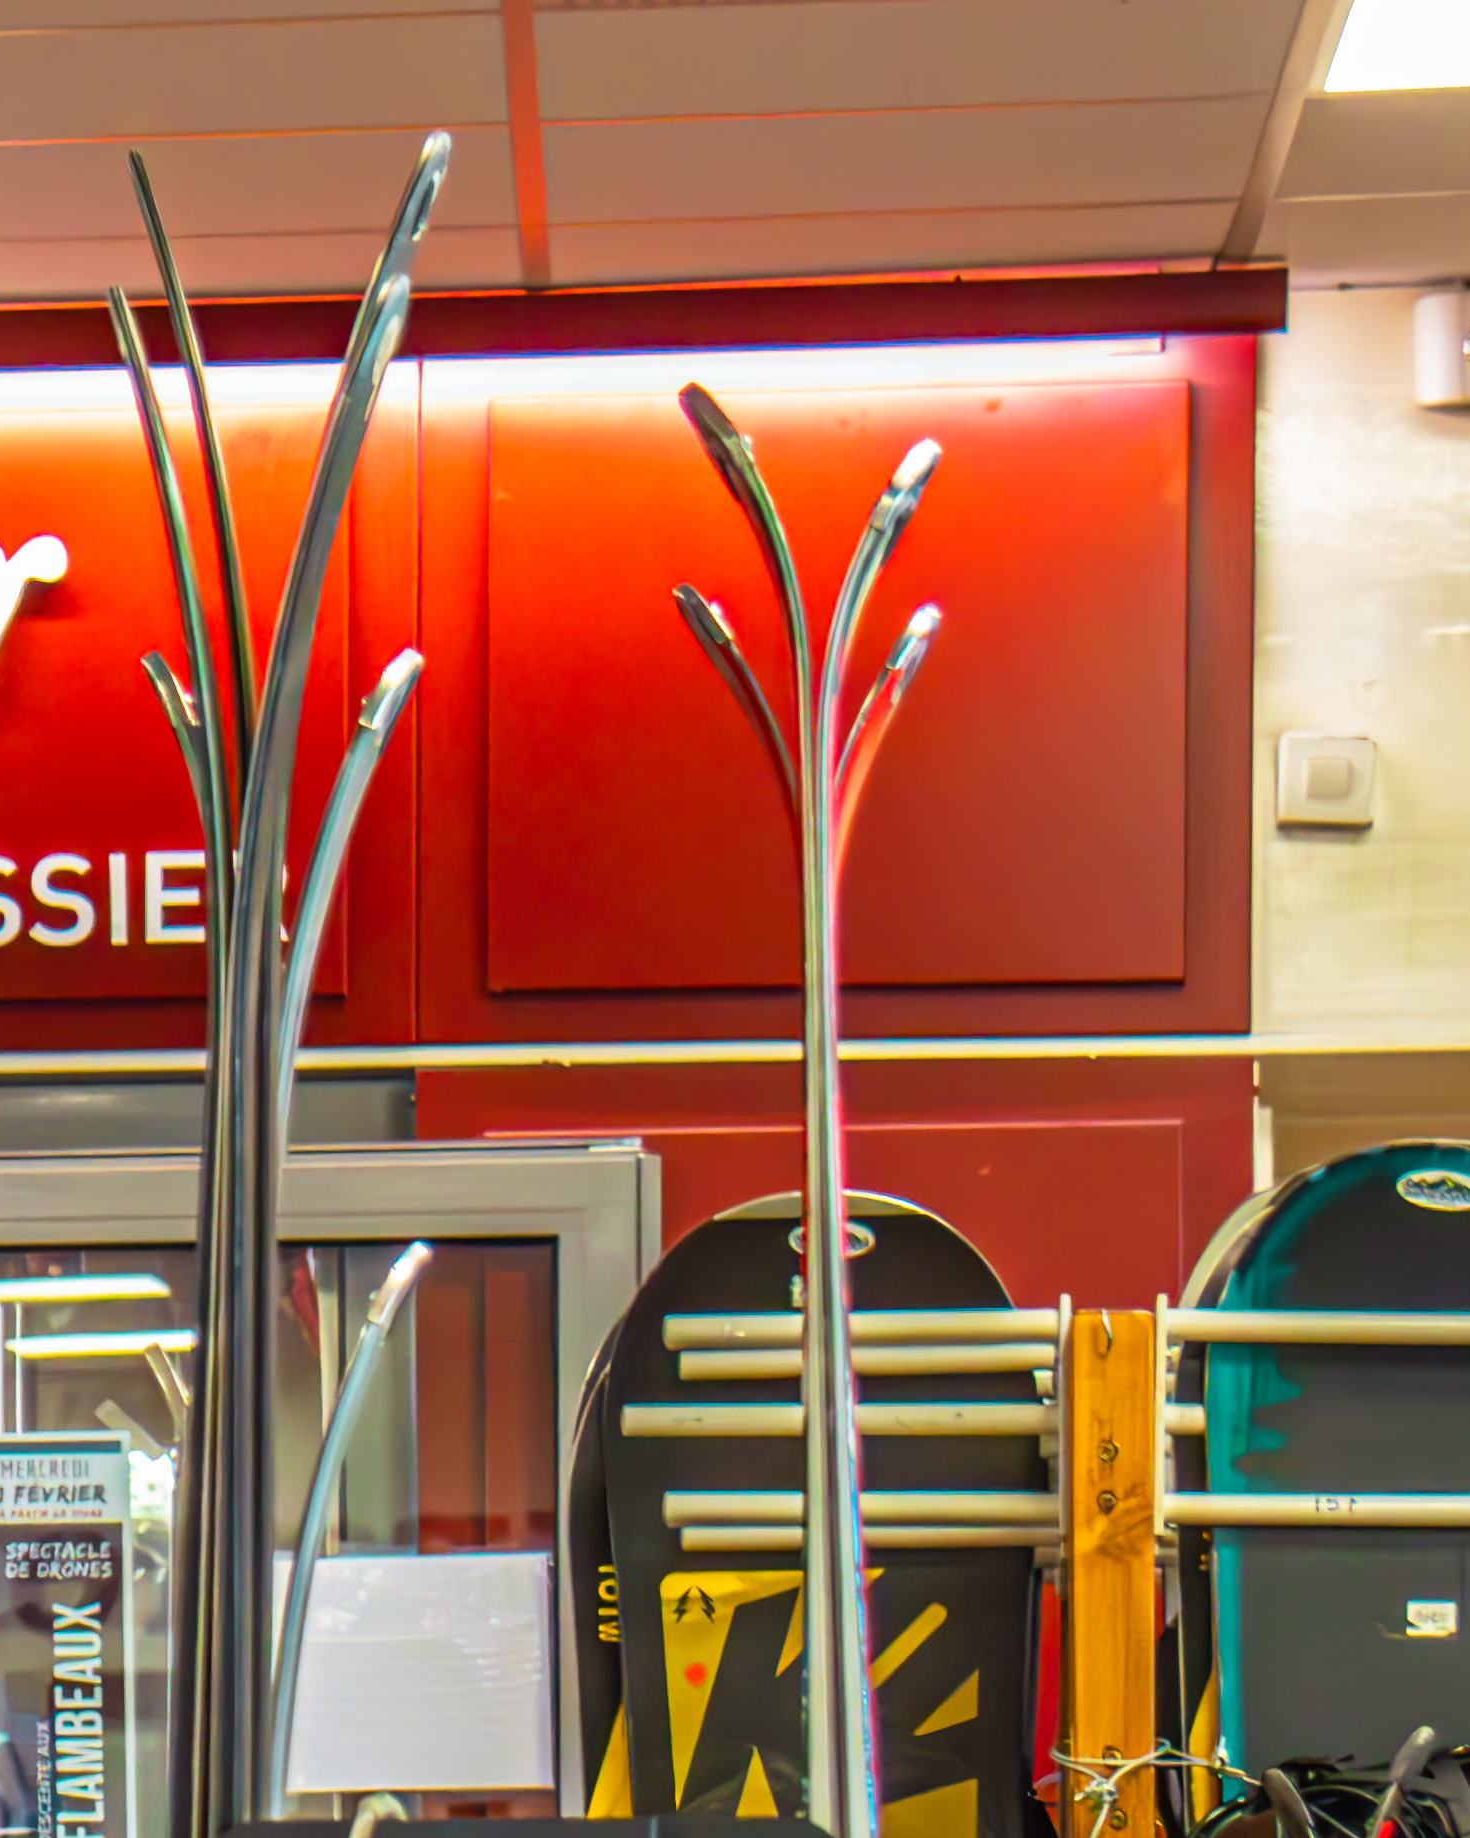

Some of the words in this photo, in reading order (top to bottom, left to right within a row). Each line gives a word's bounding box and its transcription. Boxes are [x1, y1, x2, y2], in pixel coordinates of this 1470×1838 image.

[0, 1459, 90, 1480] MERCREDI
[5, 1541, 111, 1561] SPECTACLE
[4, 1561, 30, 1579] DE
[36, 1561, 113, 1580] DRONES
[38, 1720, 51, 1757] AUX
